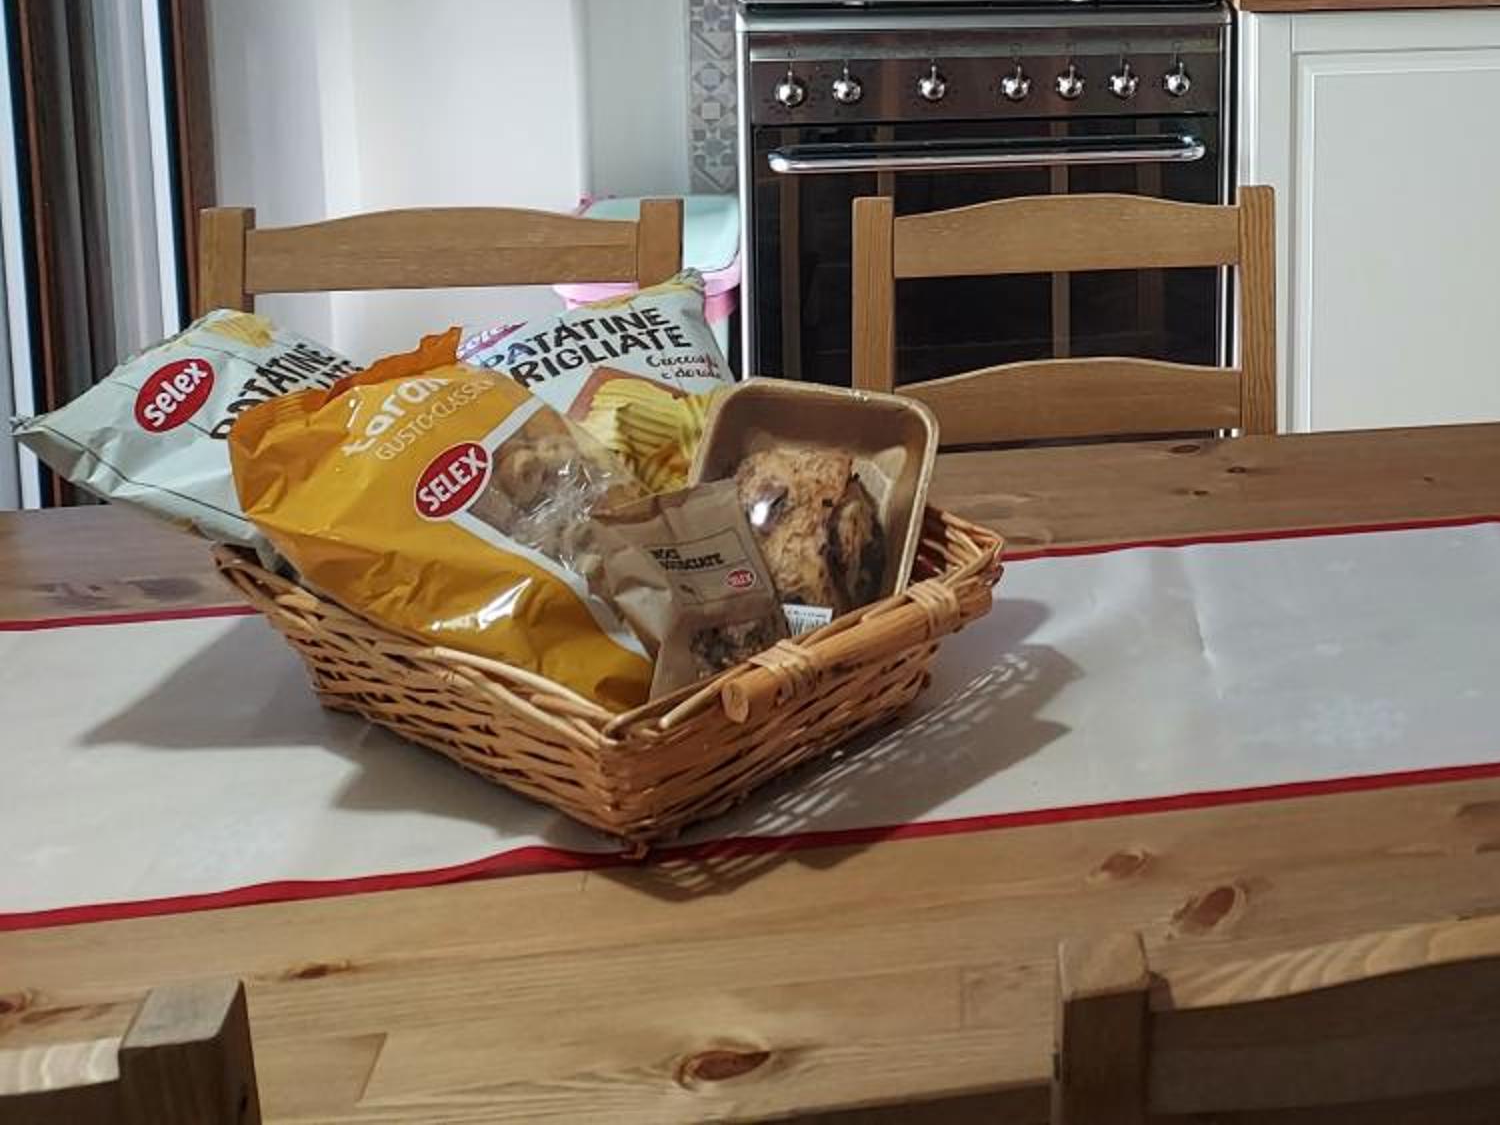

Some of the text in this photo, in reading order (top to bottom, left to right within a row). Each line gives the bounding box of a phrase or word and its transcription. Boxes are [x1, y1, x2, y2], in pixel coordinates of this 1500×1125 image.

[478, 307, 670, 369] PATATINE
[508, 325, 693, 388] RIGLIATE
[143, 361, 209, 428] selex
[418, 446, 490, 512] SELEX
